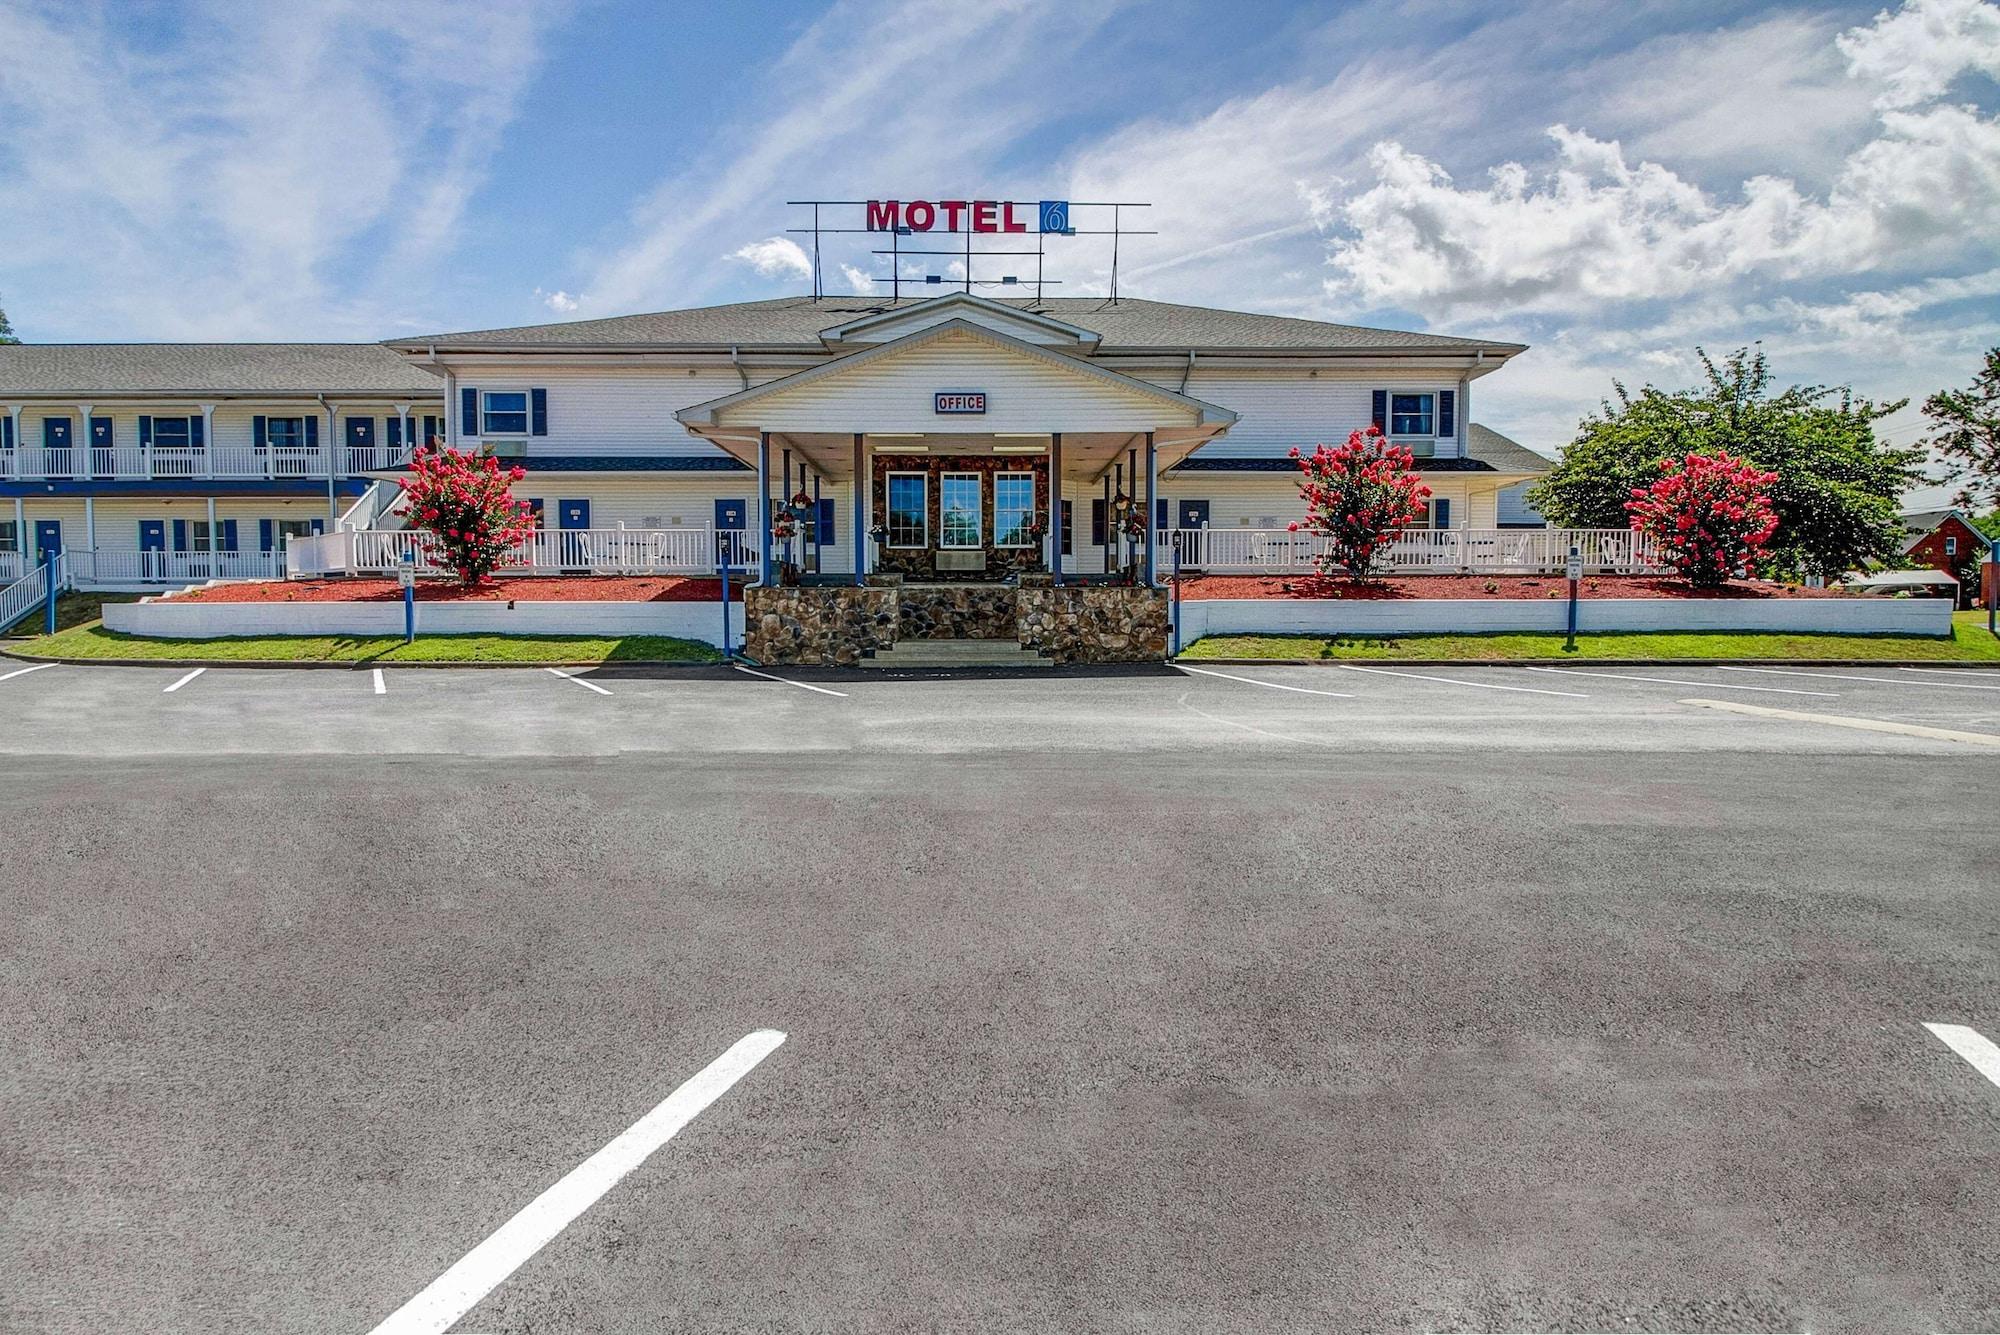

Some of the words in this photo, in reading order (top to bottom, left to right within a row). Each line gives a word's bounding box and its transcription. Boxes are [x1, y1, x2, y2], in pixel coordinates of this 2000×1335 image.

[867, 200, 1026, 233] MOTEL
[1043, 201, 1067, 231] 6
[939, 396, 983, 410] OFFICE
